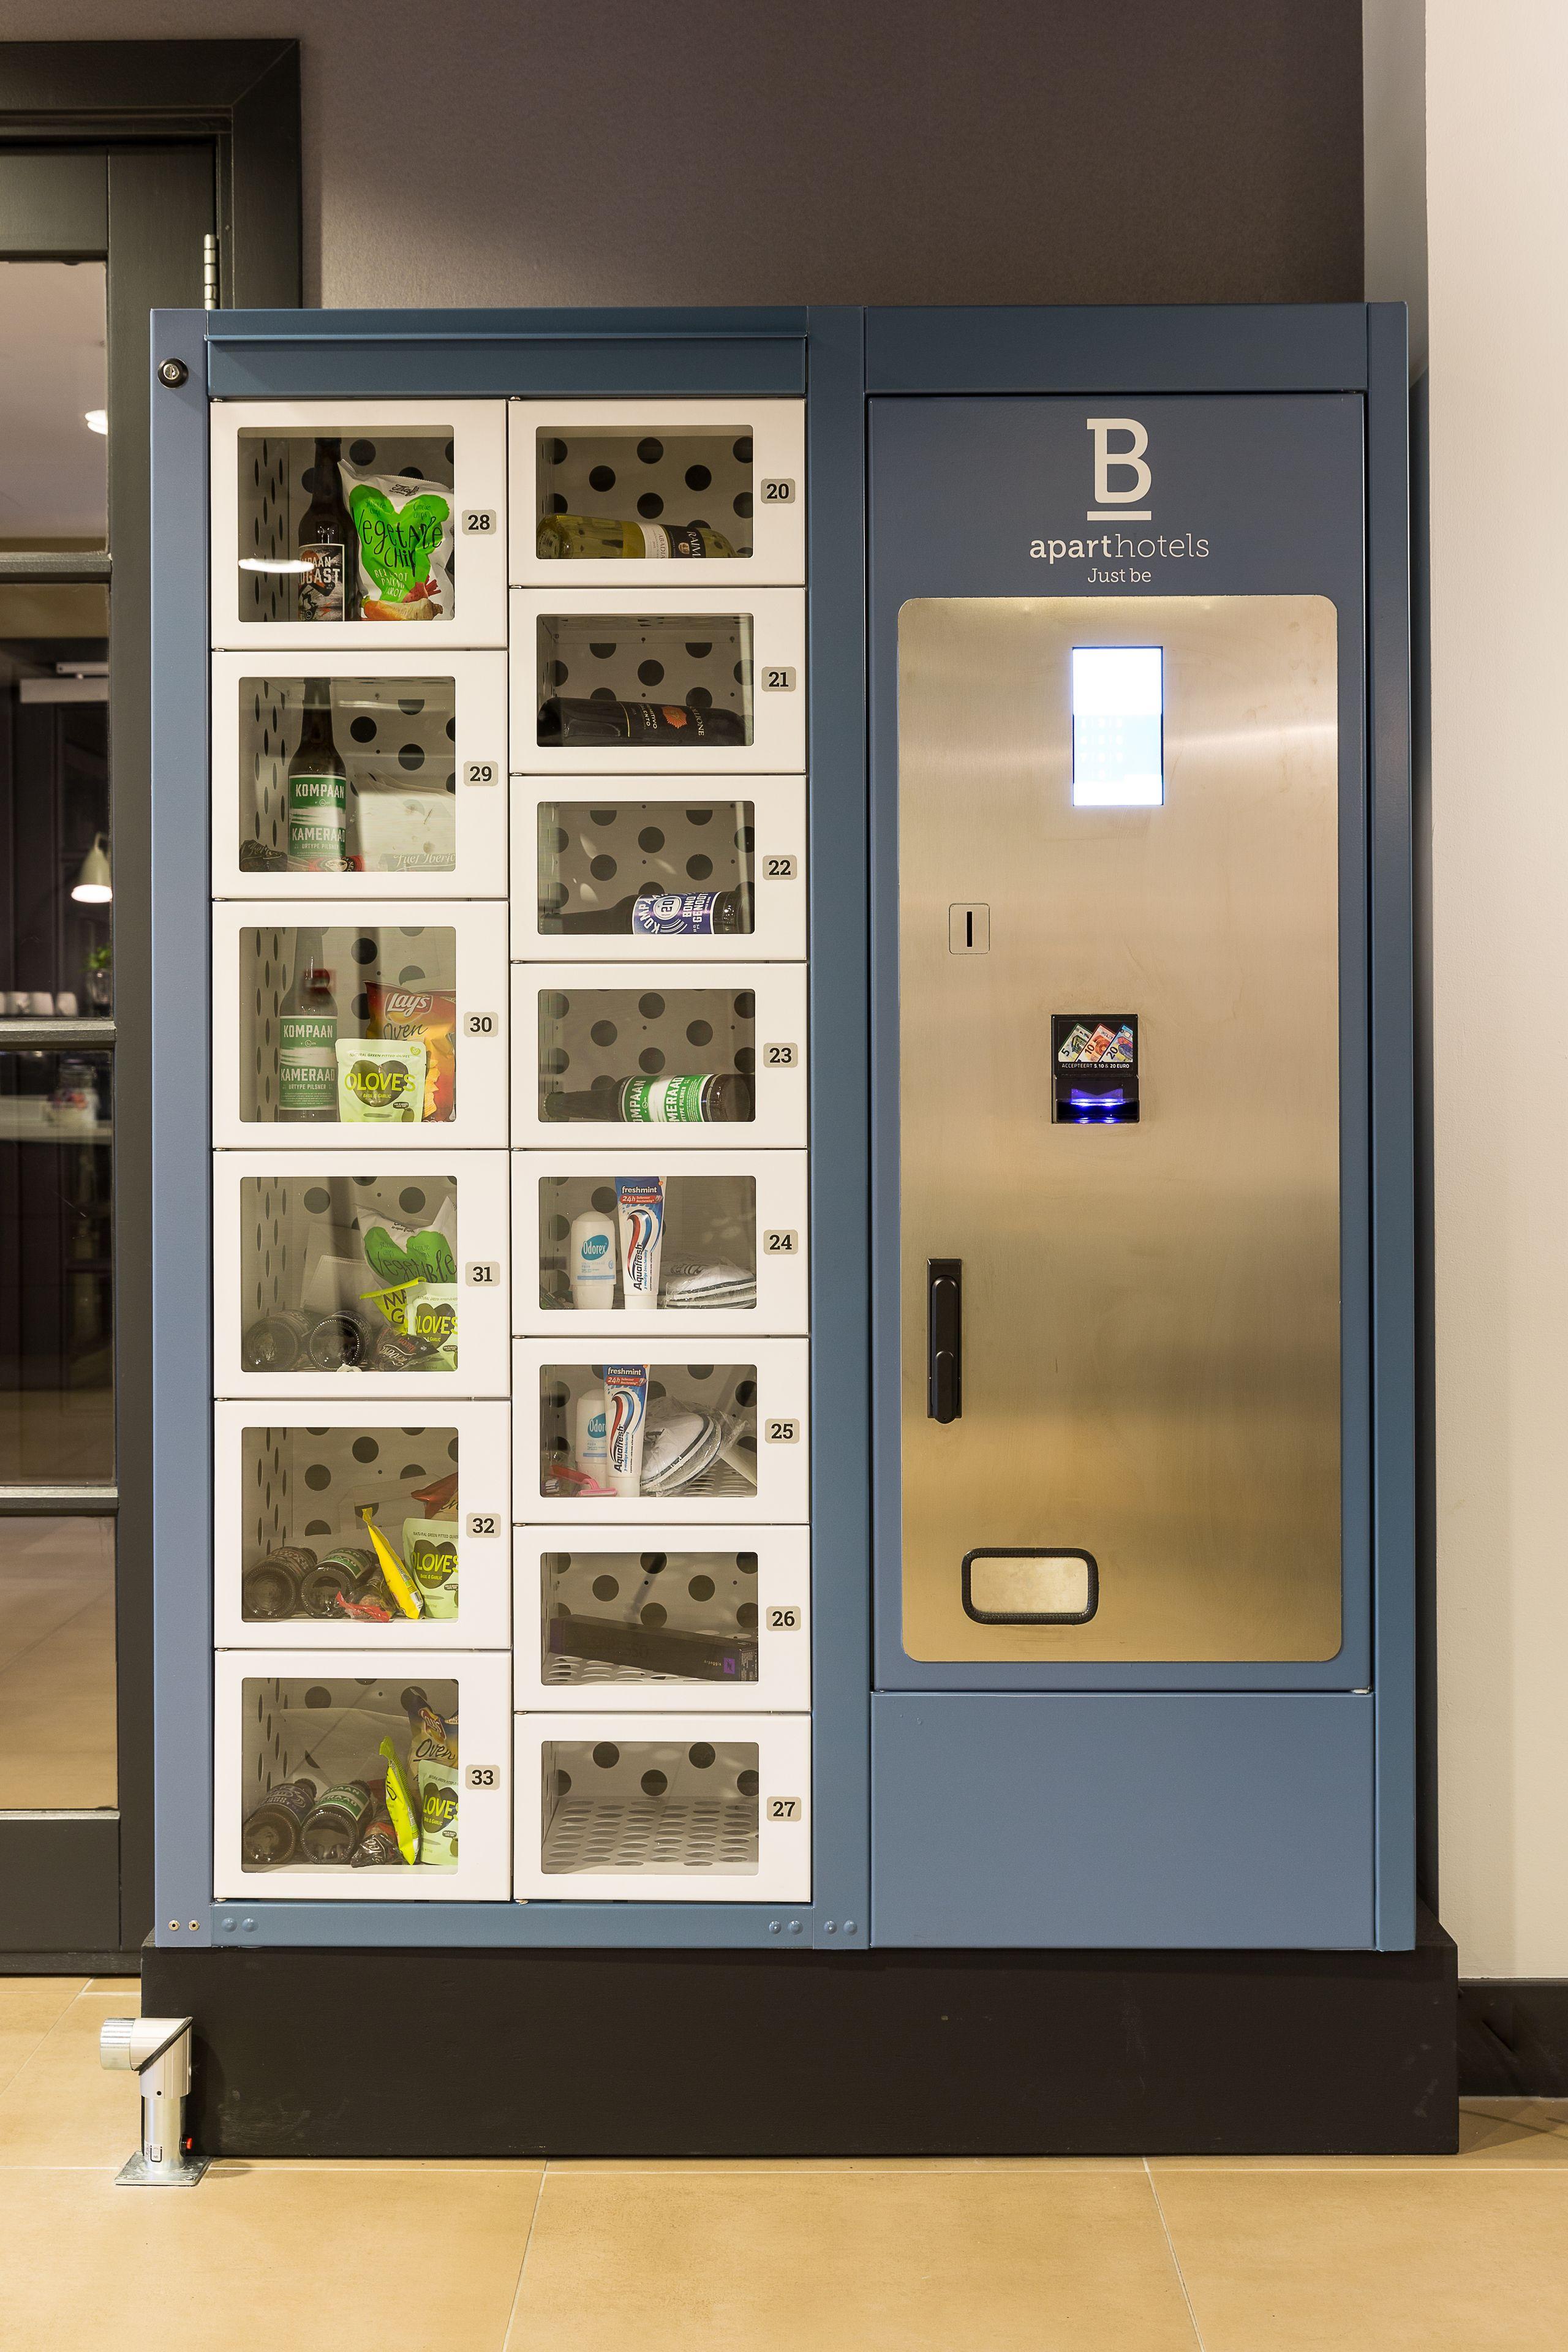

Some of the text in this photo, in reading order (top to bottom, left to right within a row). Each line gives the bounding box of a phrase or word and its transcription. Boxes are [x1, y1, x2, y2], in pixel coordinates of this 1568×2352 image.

[1087, 418, 1152, 503] B
[766, 483, 790, 499] 20
[467, 514, 491, 530] 28
[1029, 533, 1210, 565] aparthotels
[1087, 568, 1152, 583] Just be
[768, 671, 789, 688] 21
[469, 766, 492, 782] 29
[295, 783, 344, 799] KOMPAAN
[292, 827, 345, 843] KAMERAAD
[768, 859, 791, 876] 22
[661, 900, 674, 913] 20
[682, 895, 696, 918] BOND
[284, 1025, 333, 1038] KOMPAAN
[383, 1022, 429, 1040] Oven
[469, 1017, 492, 1033] 30
[769, 1047, 792, 1063] 23
[1061, 1048, 1070, 1057] 5
[1084, 1044, 1095, 1055] 10
[1106, 1046, 1118, 1060] 20
[281, 1068, 336, 1082] KAMERAAD
[344, 1072, 417, 1092] OLOVES
[583, 1241, 606, 1255] Odorex
[769, 1234, 793, 1250] 24
[472, 1266, 493, 1282] 31
[633, 1243, 644, 1291] Aquafresh
[608, 1366, 641, 1376] freshmint
[771, 1423, 794, 1439] 25
[614, 1425, 625, 1473] Aquafresh
[472, 1518, 495, 1534] 32
[772, 1610, 795, 1627] 26
[415, 1738, 456, 1760] Oven
[471, 1770, 494, 1785] 33
[772, 1801, 796, 1817] 27
